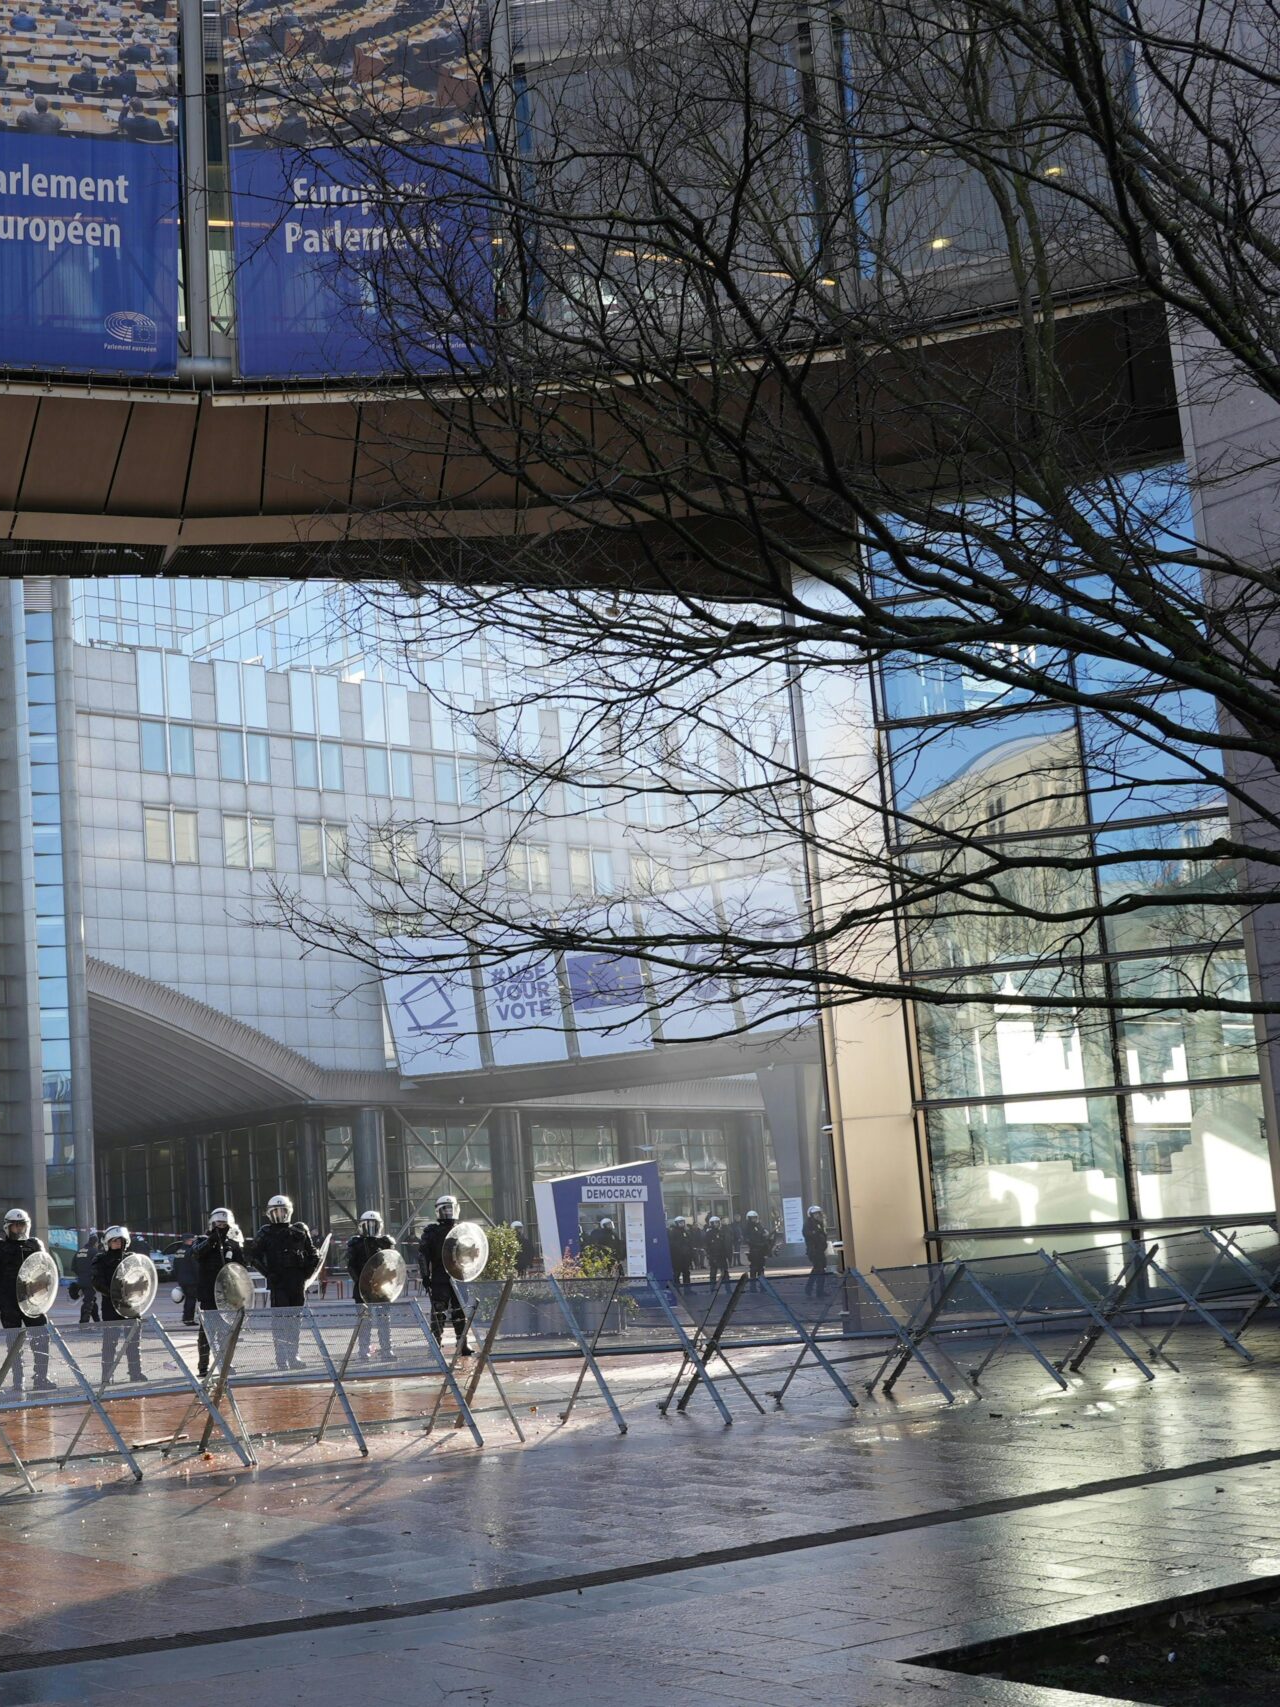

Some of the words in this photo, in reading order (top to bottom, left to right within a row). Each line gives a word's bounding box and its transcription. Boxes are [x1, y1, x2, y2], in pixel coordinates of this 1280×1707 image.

[491, 962, 547, 984] #USE
[493, 981, 550, 1003] YOUR
[496, 1000, 552, 1021] VOTE
[586, 1175, 626, 1185] TOGETHER
[627, 1175, 643, 1184] FOR
[586, 1188, 643, 1199] DEMOCRACY
